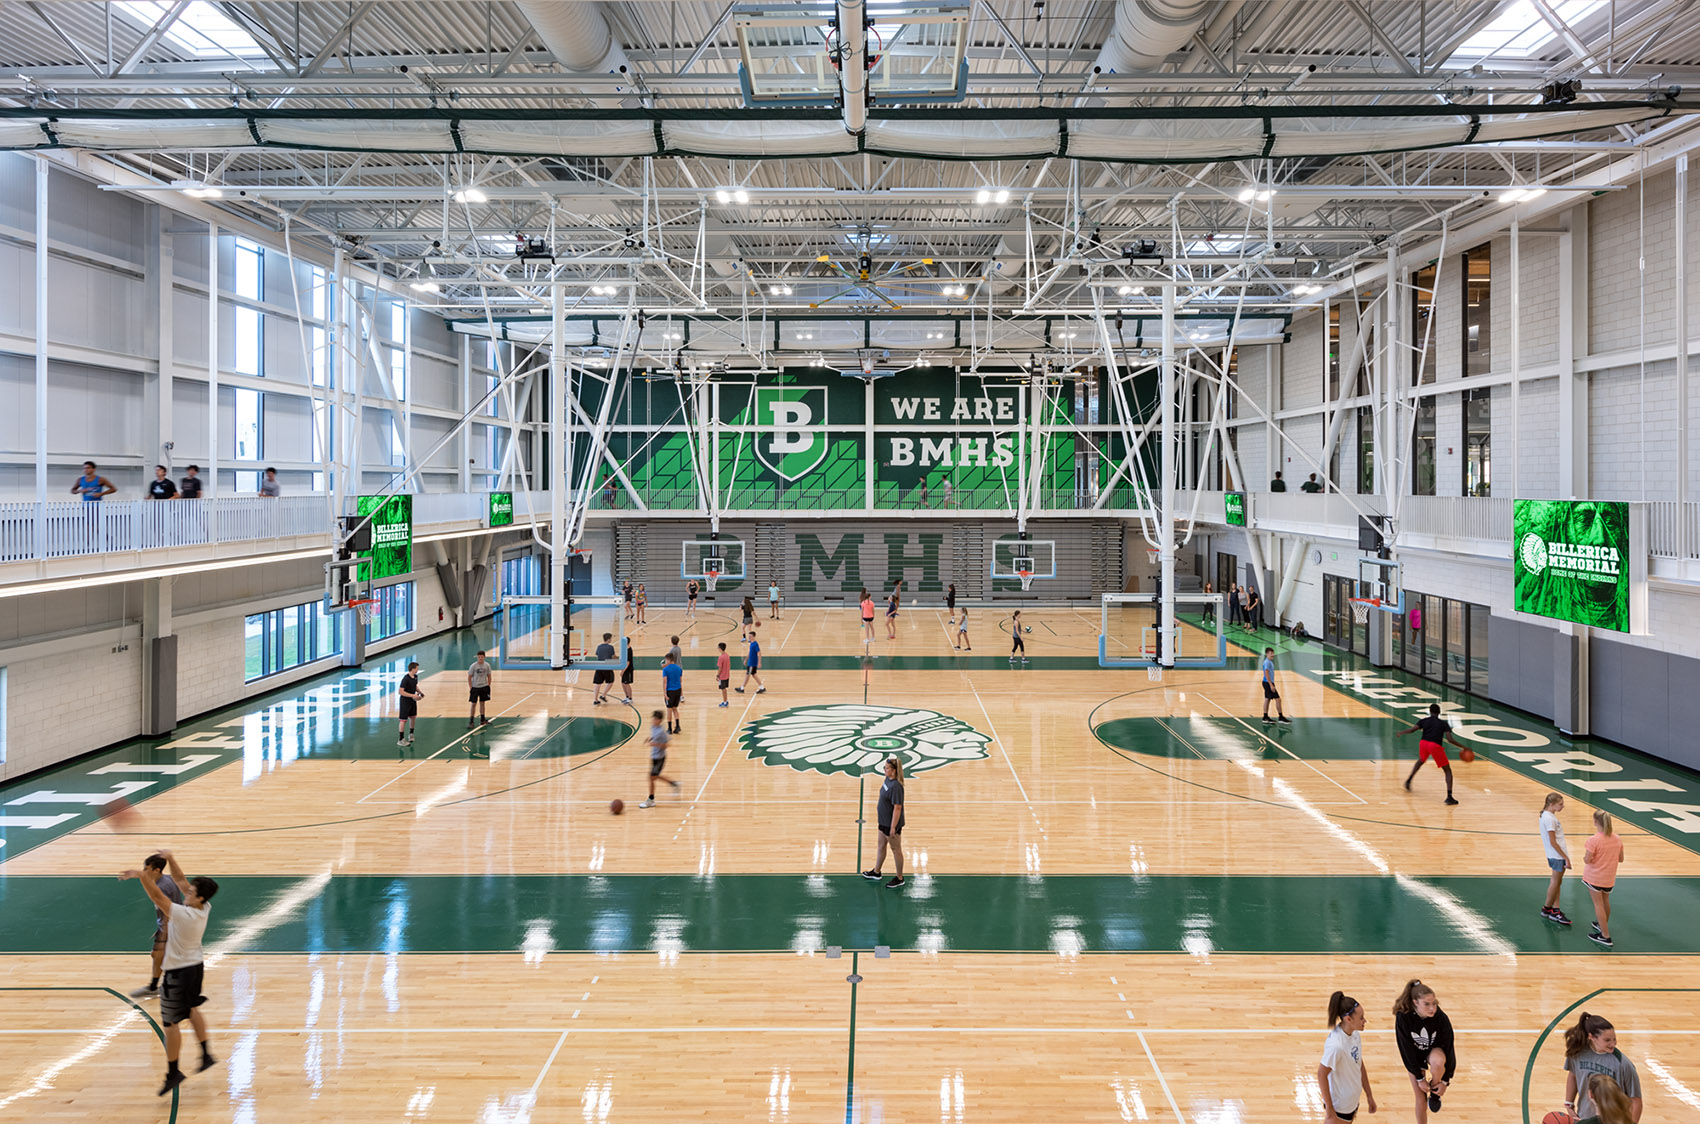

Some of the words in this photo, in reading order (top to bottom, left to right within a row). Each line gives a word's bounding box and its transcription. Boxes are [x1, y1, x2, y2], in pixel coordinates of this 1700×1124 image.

[891, 398, 940, 419] WE
[951, 398, 1013, 419] ARE
[769, 401, 814, 453] B
[890, 438, 1013, 466] BMHS
[1548, 542, 1619, 561] BILLERICA
[1549, 555, 1619, 574] MEMORIAL
